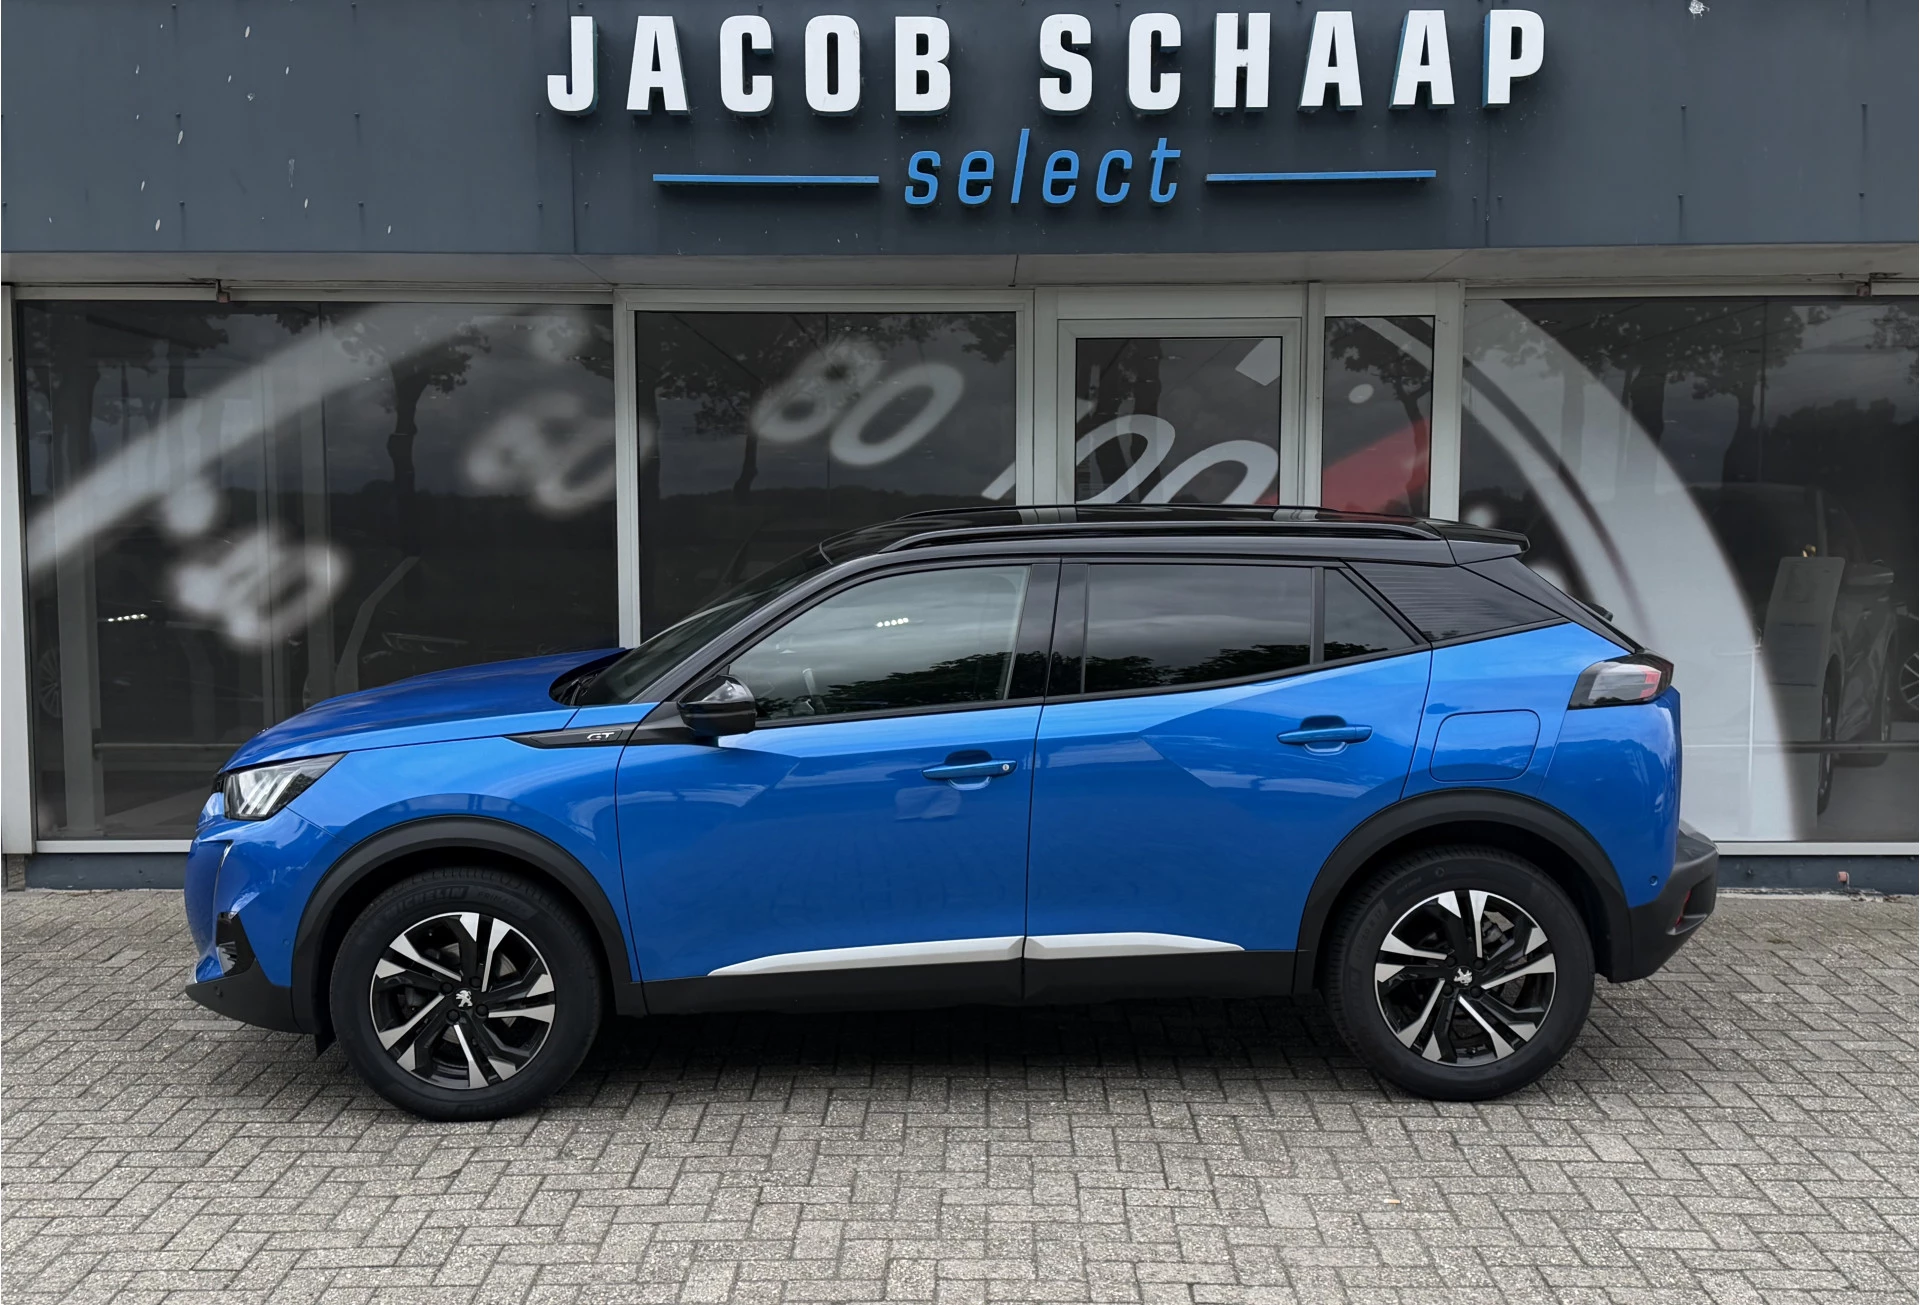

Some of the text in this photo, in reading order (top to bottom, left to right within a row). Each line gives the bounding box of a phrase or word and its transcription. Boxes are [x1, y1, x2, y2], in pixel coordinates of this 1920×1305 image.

[547, 9, 1545, 113] JACOB SCHAAP
[904, 128, 1182, 205] select
[586, 731, 615, 741] GT
[384, 886, 466, 918] MICHELIN
